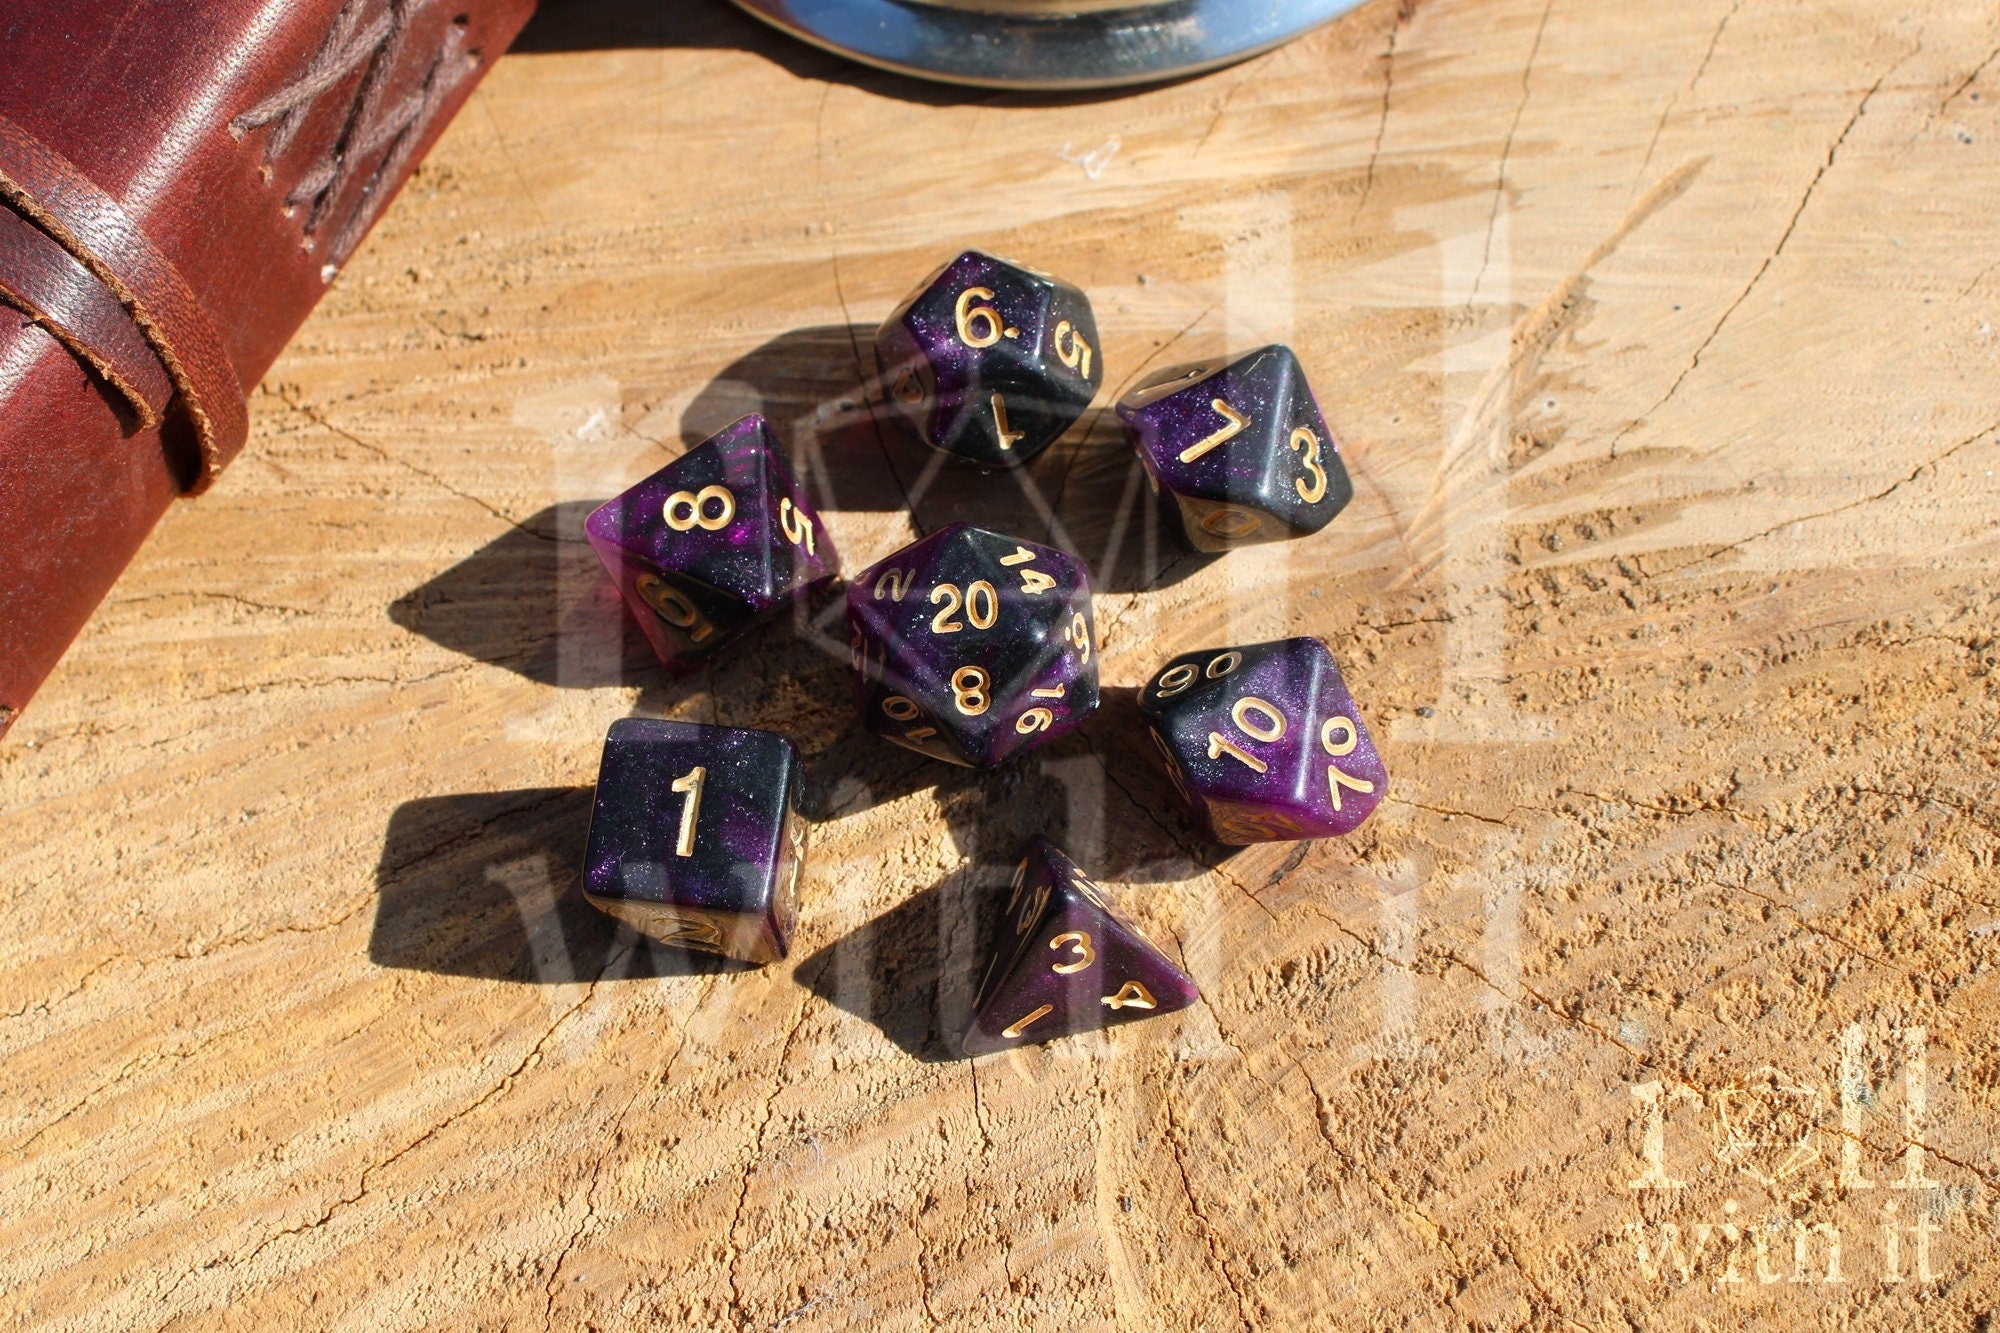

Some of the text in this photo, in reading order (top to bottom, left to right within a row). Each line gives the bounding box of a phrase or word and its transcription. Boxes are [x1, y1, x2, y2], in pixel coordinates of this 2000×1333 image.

[1055, 320, 1092, 379] 5
[991, 393, 1025, 449] 1
[1290, 428, 1327, 503] 3
[662, 484, 736, 531] 8
[780, 497, 814, 556] 5
[874, 568, 916, 602] 2
[1000, 546, 1056, 595] 14
[930, 580, 999, 633] 20
[951, 665, 991, 716] 8
[1157, 651, 1242, 698] 90
[1015, 683, 1065, 735] 16
[1208, 697, 1287, 773] 10
[1321, 716, 1374, 811] 70
[671, 766, 706, 857] 1
[1049, 930, 1096, 974] 3
[1001, 1003, 1054, 1038] 1
[1101, 980, 1158, 1010] 4
